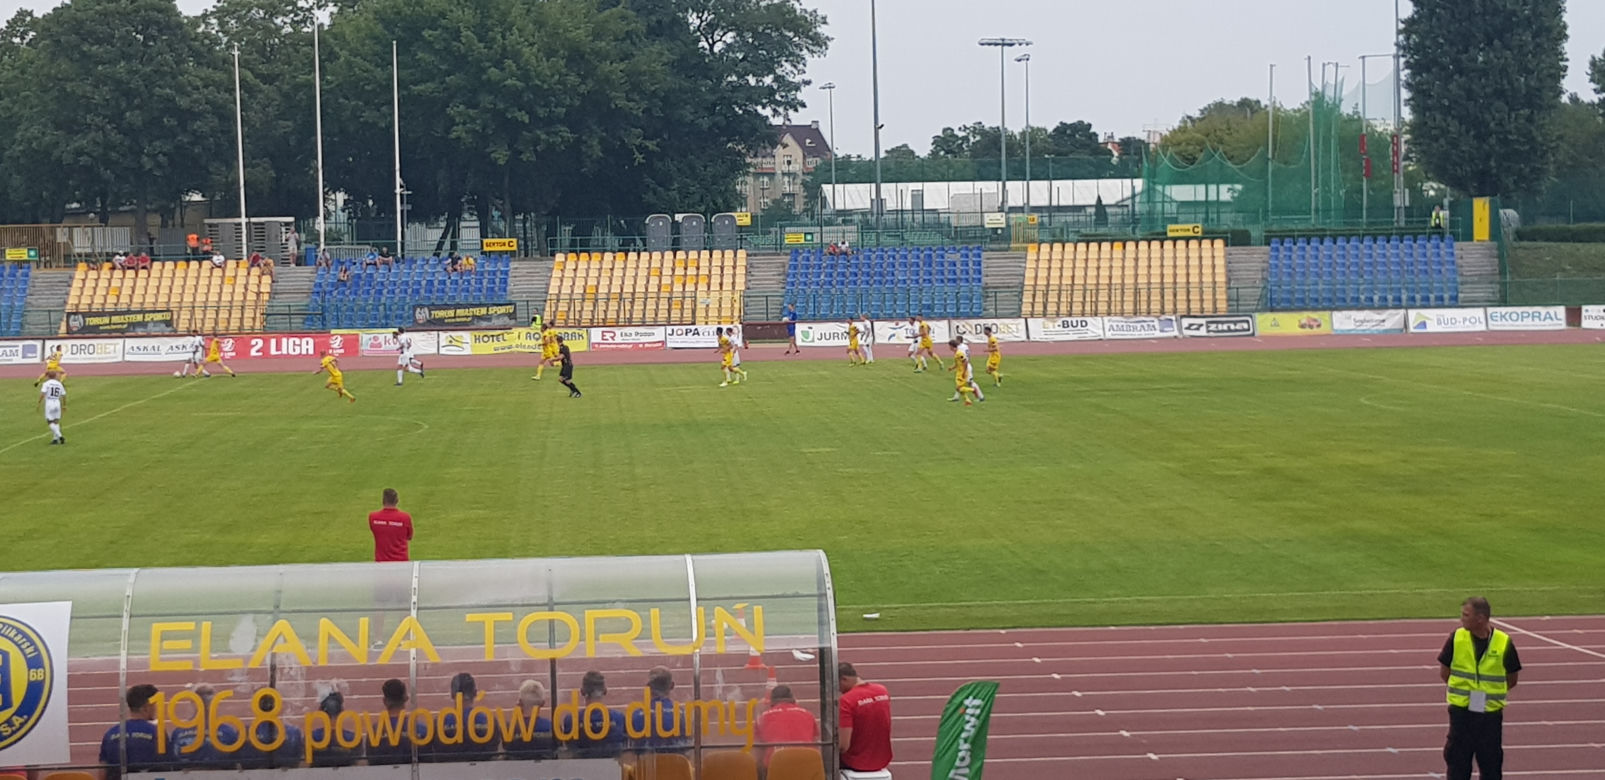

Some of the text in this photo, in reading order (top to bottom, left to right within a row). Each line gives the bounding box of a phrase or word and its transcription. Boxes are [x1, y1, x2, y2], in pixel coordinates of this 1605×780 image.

[1192, 225, 1200, 235] C
[507, 240, 514, 248] C
[1490, 311, 1562, 322] EKOPRAL
[668, 327, 700, 337] JOPA
[474, 334, 507, 344] HOTEL
[129, 344, 161, 352] ASKAL
[250, 338, 263, 356] 2
[270, 337, 315, 356] LIGA
[50, 387, 60, 397] 16
[150, 603, 764, 671] ELANA TORUŃ
[29, 668, 45, 681] 68
[148, 686, 757, 764] 1968 powodów do dumy
